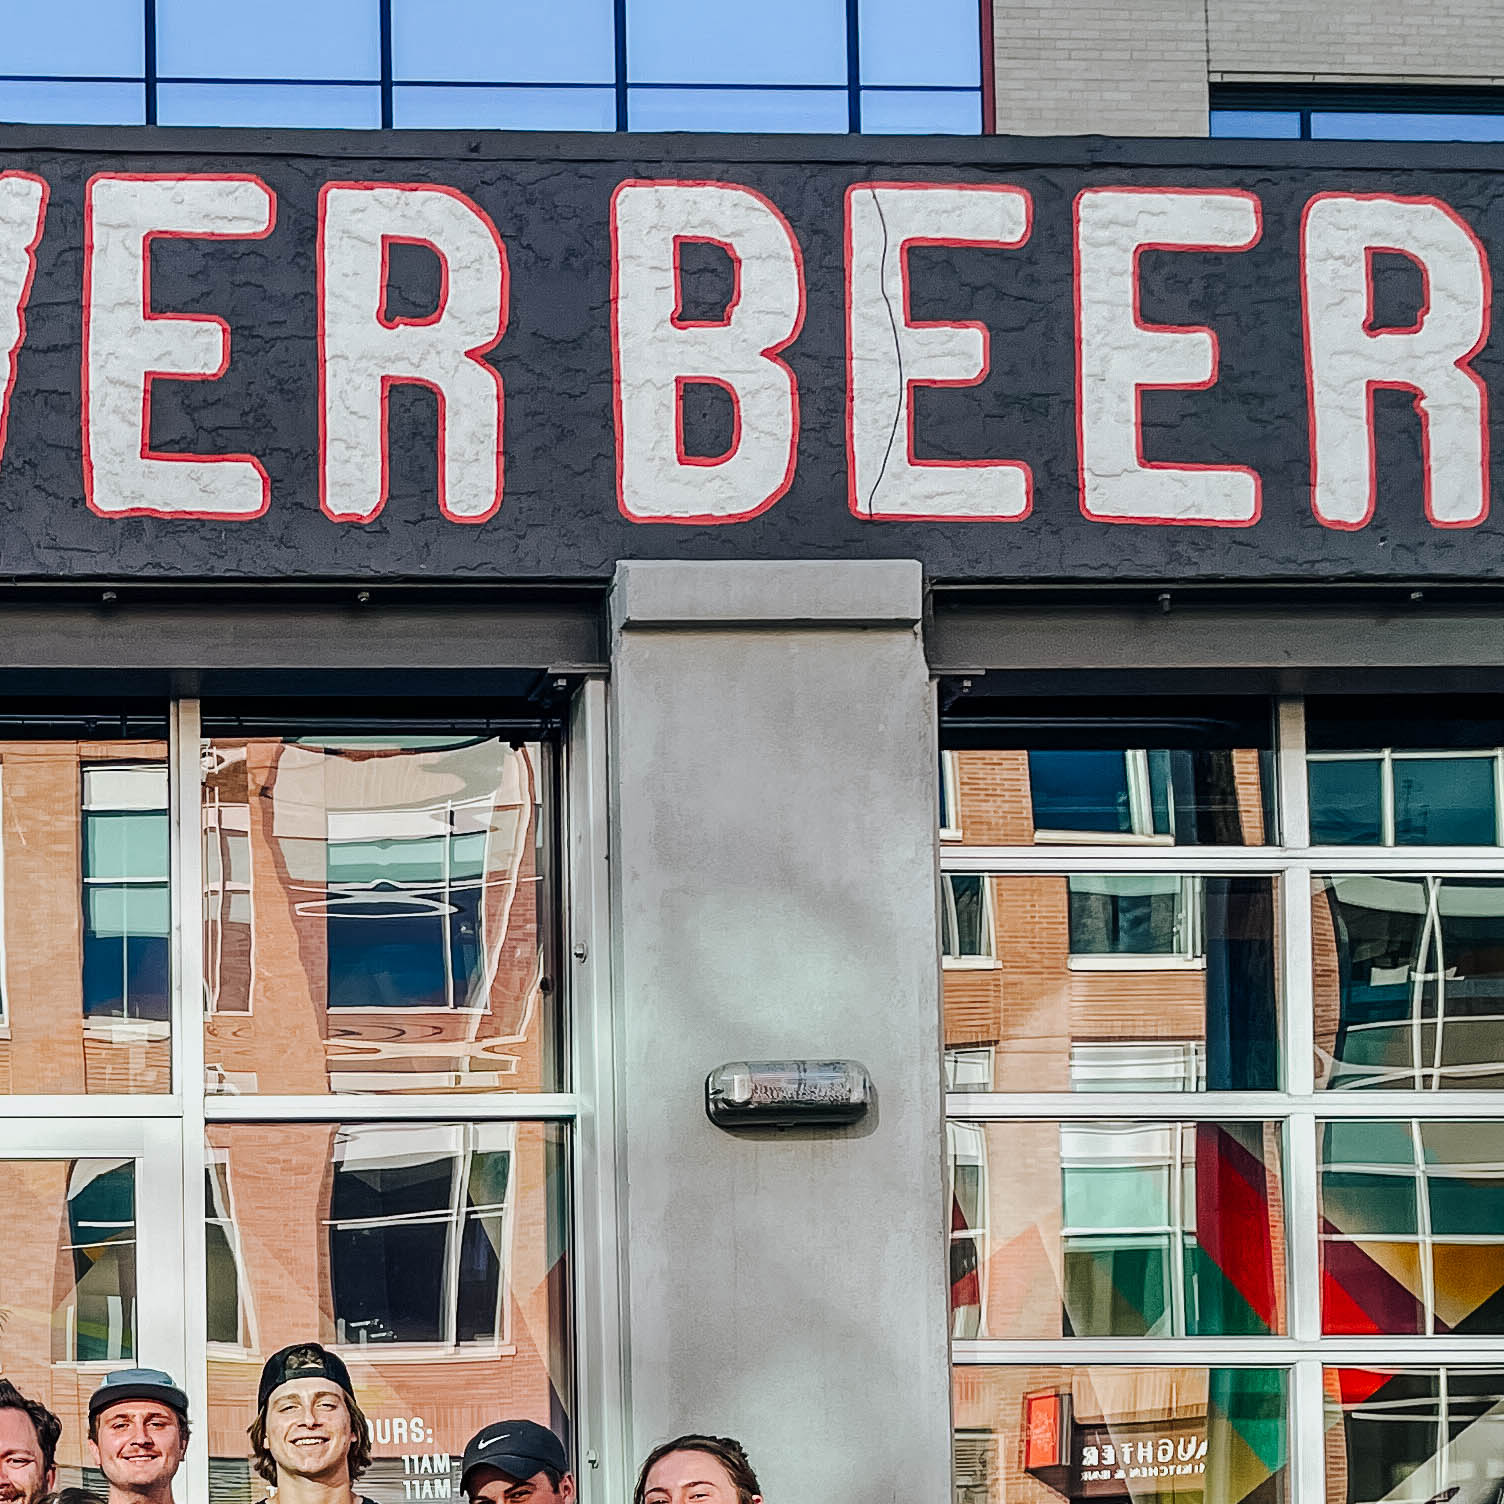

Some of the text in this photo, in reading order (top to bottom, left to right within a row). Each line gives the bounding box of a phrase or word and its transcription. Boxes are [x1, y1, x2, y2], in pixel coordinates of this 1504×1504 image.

[610, 179, 1491, 531] BEER
[365, 1417, 433, 1445] OURS:
[401, 1453, 461, 1475] 11AM-
[402, 1479, 461, 1500] 11AM-
